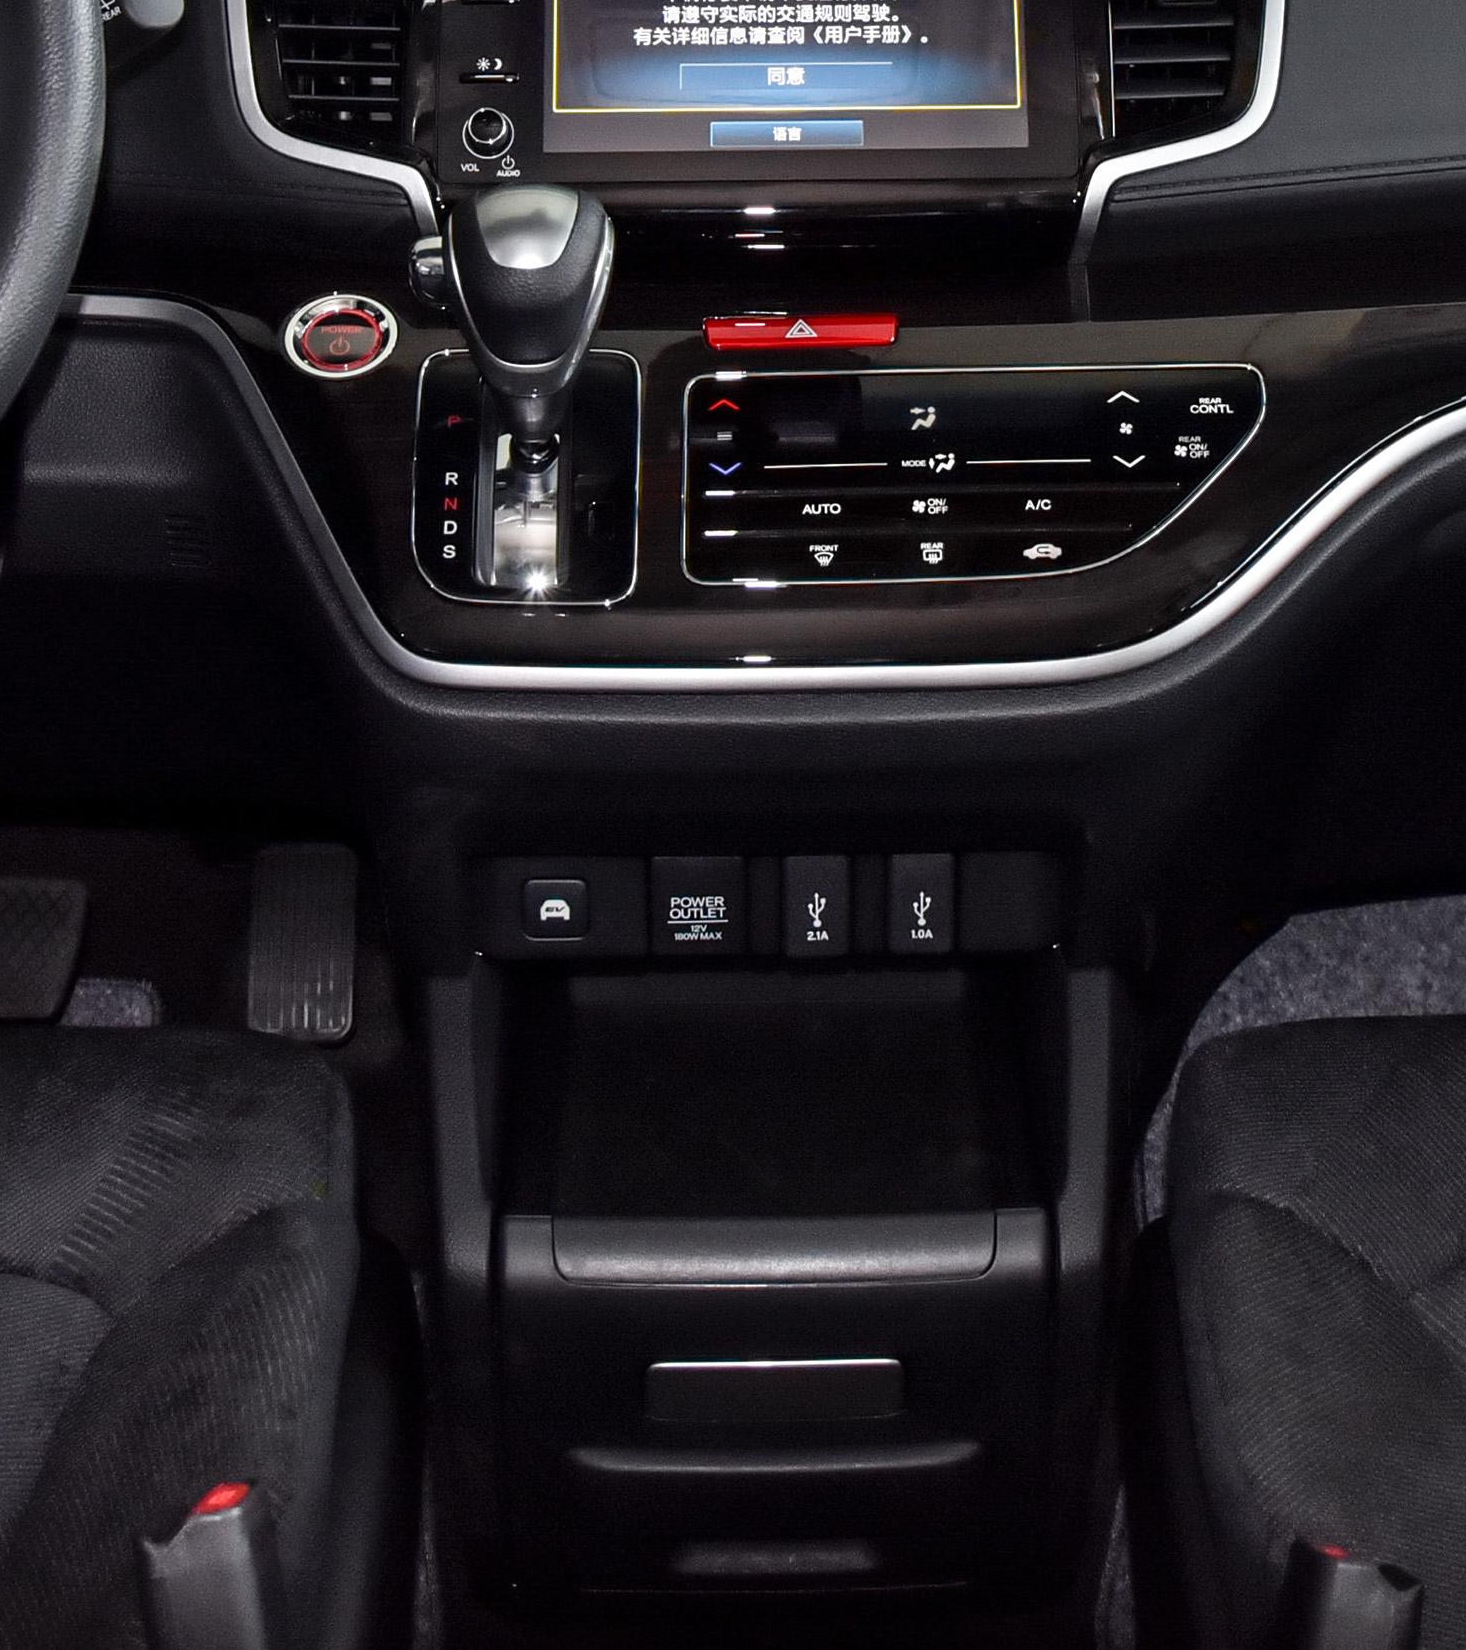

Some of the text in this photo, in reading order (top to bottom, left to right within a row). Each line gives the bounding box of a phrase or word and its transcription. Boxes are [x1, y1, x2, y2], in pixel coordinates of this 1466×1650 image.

[662, 4, 898, 23] 请遵守实际的交通规则驾驶。
[634, 25, 927, 45] 有关详细信息请查阅《用户手册》。
[768, 67, 805, 86] 同意
[773, 125, 802, 141] 语言
[461, 163, 479, 171] VOL
[497, 168, 520, 176] AUDIO
[320, 324, 366, 335] POWER
[1190, 403, 1233, 413] CONTL
[448, 415, 461, 427] P
[1179, 436, 1201, 444] REAR
[445, 472, 458, 485] R
[445, 498, 457, 510] N
[802, 503, 841, 514] AUTO
[1025, 499, 1051, 510] A/C
[928, 506, 948, 515] OFF
[444, 521, 457, 534] D
[443, 545, 455, 558] S
[810, 545, 838, 553] FRONT
[921, 543, 943, 551] REAR
[671, 897, 725, 909] POWER
[670, 906, 726, 919] OUTLET
[675, 930, 722, 940] 180W MAX
[690, 925, 708, 934] 12V
[912, 929, 933, 938] 1.0A
[807, 931, 828, 940] 2.1A
